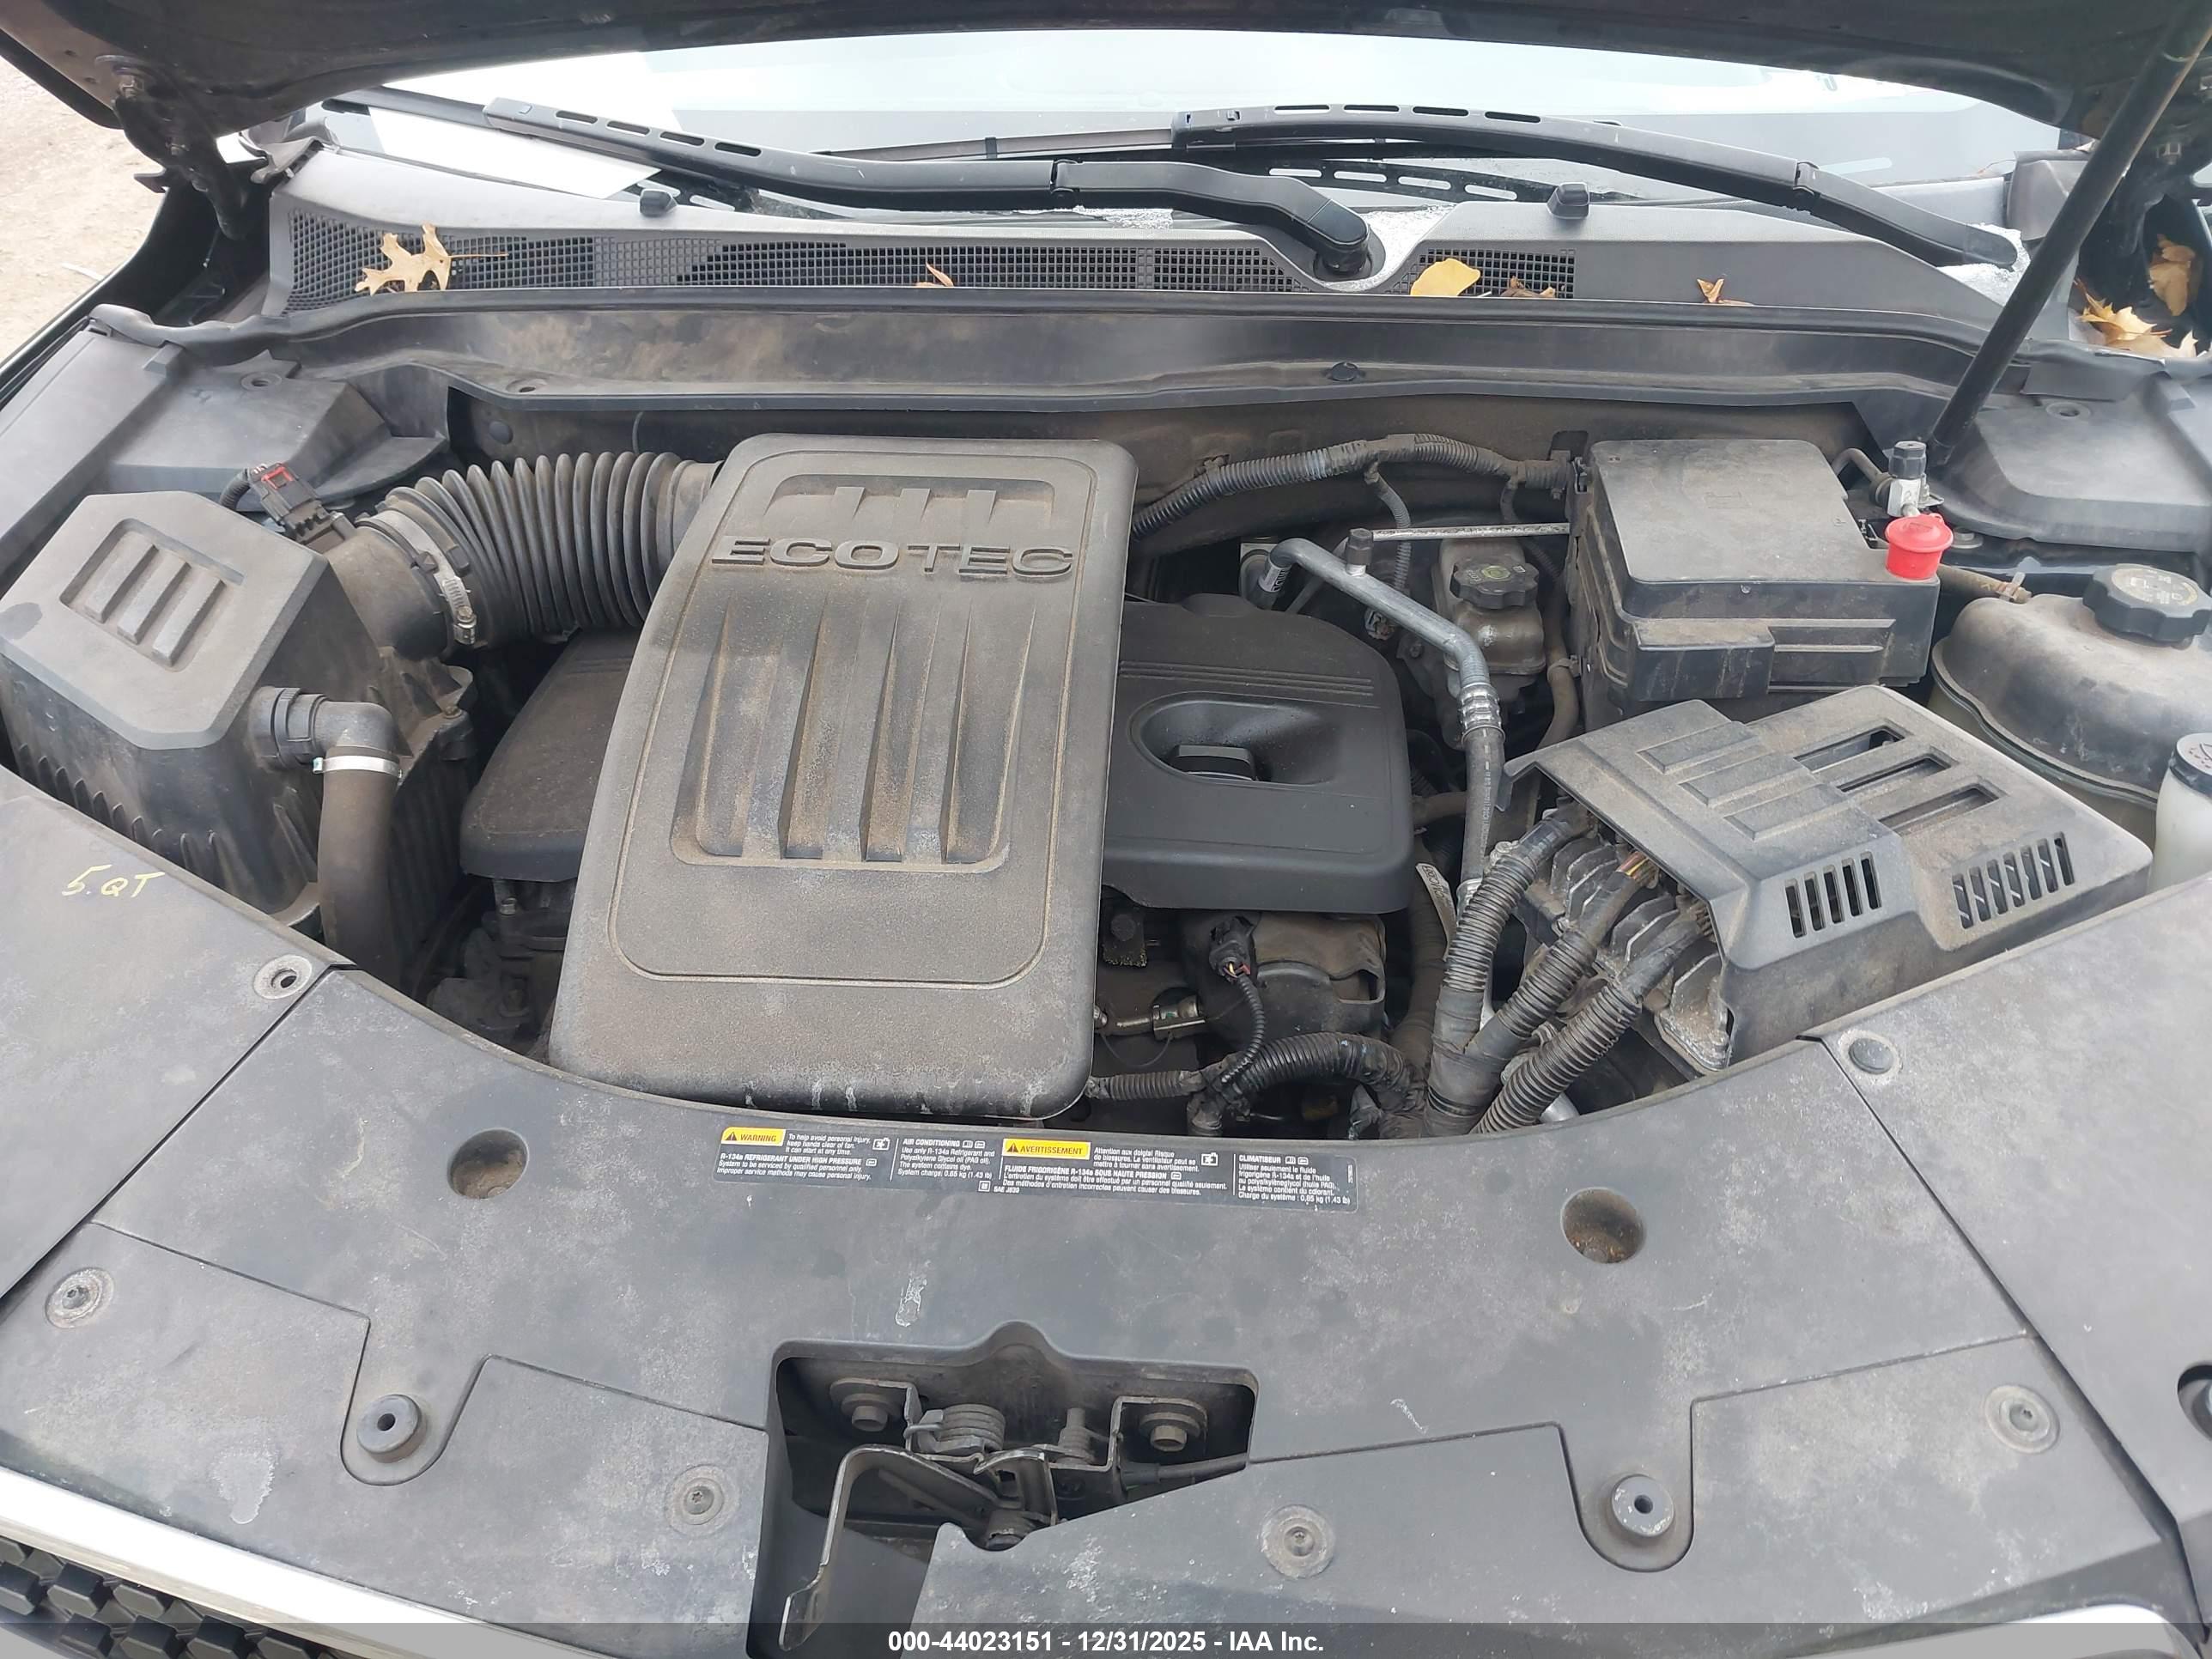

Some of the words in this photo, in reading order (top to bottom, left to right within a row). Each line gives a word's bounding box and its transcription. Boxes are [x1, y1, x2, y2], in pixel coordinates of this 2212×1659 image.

[710, 535, 1073, 578] ECOTEC
[740, 1133, 776, 1142] WARNING
[915, 1139, 960, 1147] CONDITIONING
[1019, 1146, 1083, 1155] AVERTISSEMENT
[1238, 1155, 1281, 1164] CLIMATISEUR
[719, 1159, 741, 1168] System
[784, 1163, 792, 1171] by
[793, 1163, 817, 1171] qualified
[818, 1164, 848, 1173] personnel
[898, 1168, 920, 1176] System
[1238, 1170, 1271, 1178] frigorigène
[1272, 1171, 1294, 1180] R-134a
[1238, 1191, 1260, 1200] Charge
